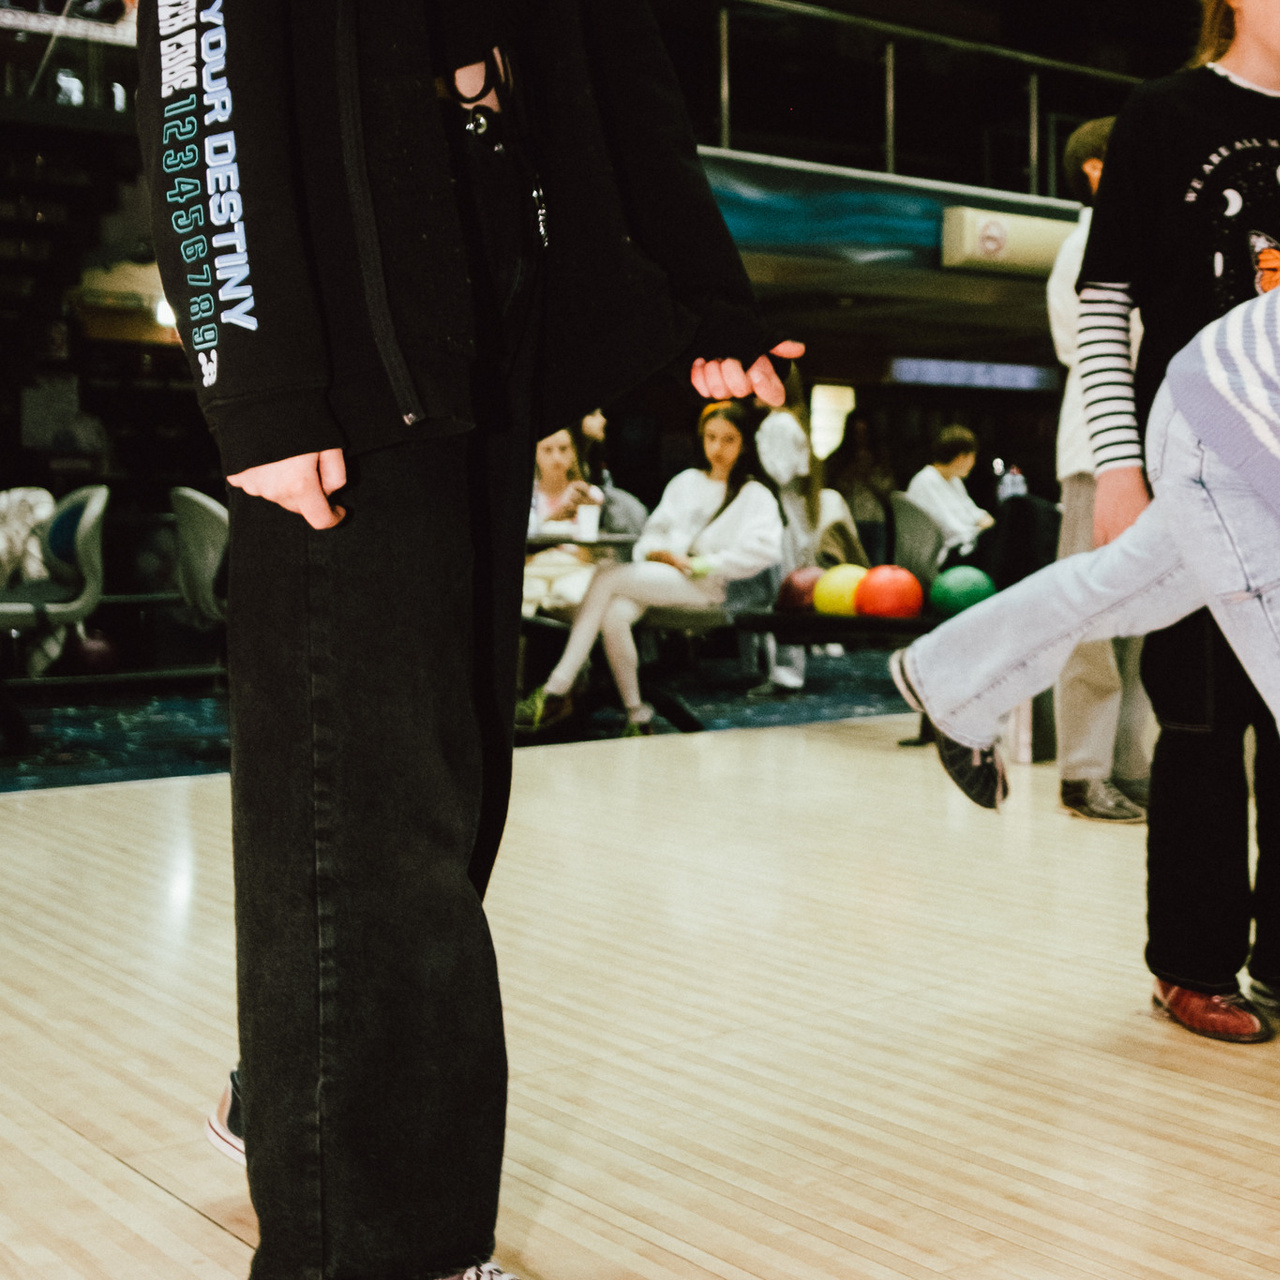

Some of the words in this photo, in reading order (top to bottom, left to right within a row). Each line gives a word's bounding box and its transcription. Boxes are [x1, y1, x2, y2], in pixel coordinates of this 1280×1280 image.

[160, 28, 198, 98] LOVE
[163, 93, 218, 350] 123456789
[1202, 145, 1231, 175] ARE
[1234, 137, 1262, 151] ALL
[204, 130, 258, 331] DESTINY
